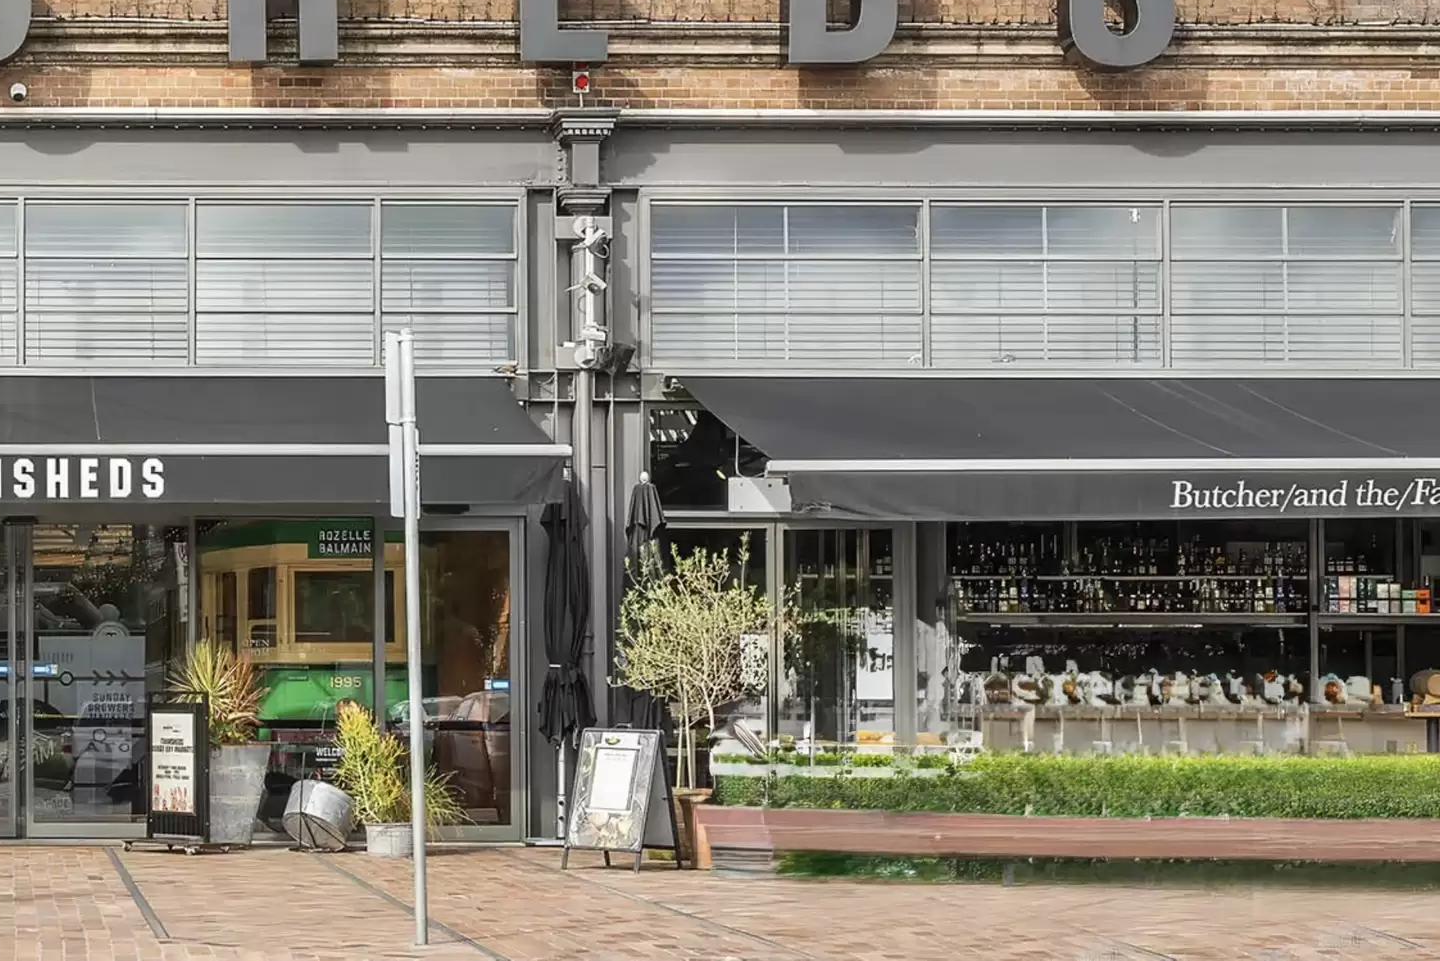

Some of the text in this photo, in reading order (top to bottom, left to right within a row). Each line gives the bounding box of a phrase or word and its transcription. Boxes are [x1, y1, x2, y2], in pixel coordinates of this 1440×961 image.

[1169, 479, 1349, 513] Butcher/and
[319, 530, 371, 541] ROZELLE
[319, 542, 372, 554] BALMAIN
[330, 676, 362, 689] 1995
